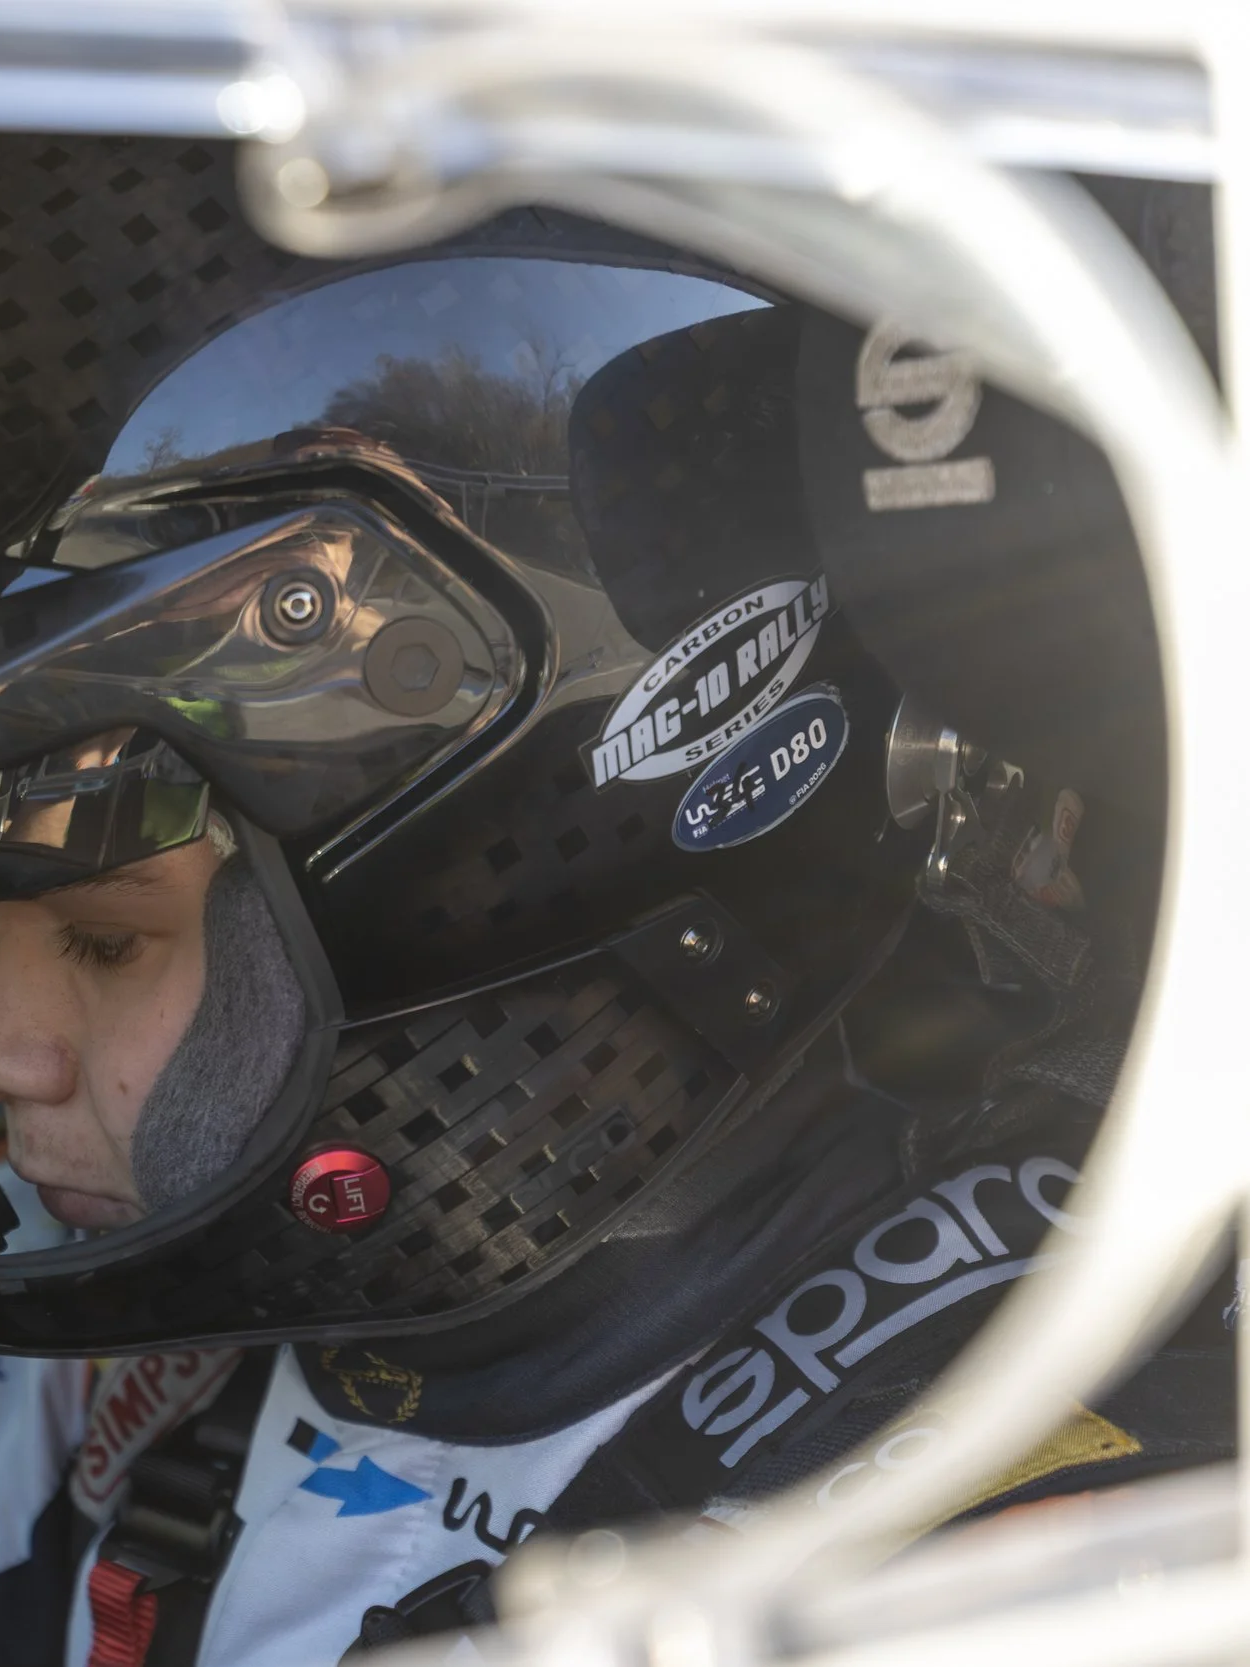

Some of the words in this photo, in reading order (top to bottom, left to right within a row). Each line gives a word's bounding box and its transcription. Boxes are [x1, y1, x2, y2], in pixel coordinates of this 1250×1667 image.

[591, 661, 731, 788] MAG-10
[736, 572, 829, 687] RALLY
[643, 595, 764, 693] CARBON
[685, 678, 786, 762] SERIES
[769, 717, 827, 782] D80
[795, 783, 810, 798] FIA
[343, 1177, 366, 1213] LIFT
[682, 1156, 1087, 1440] sparc
